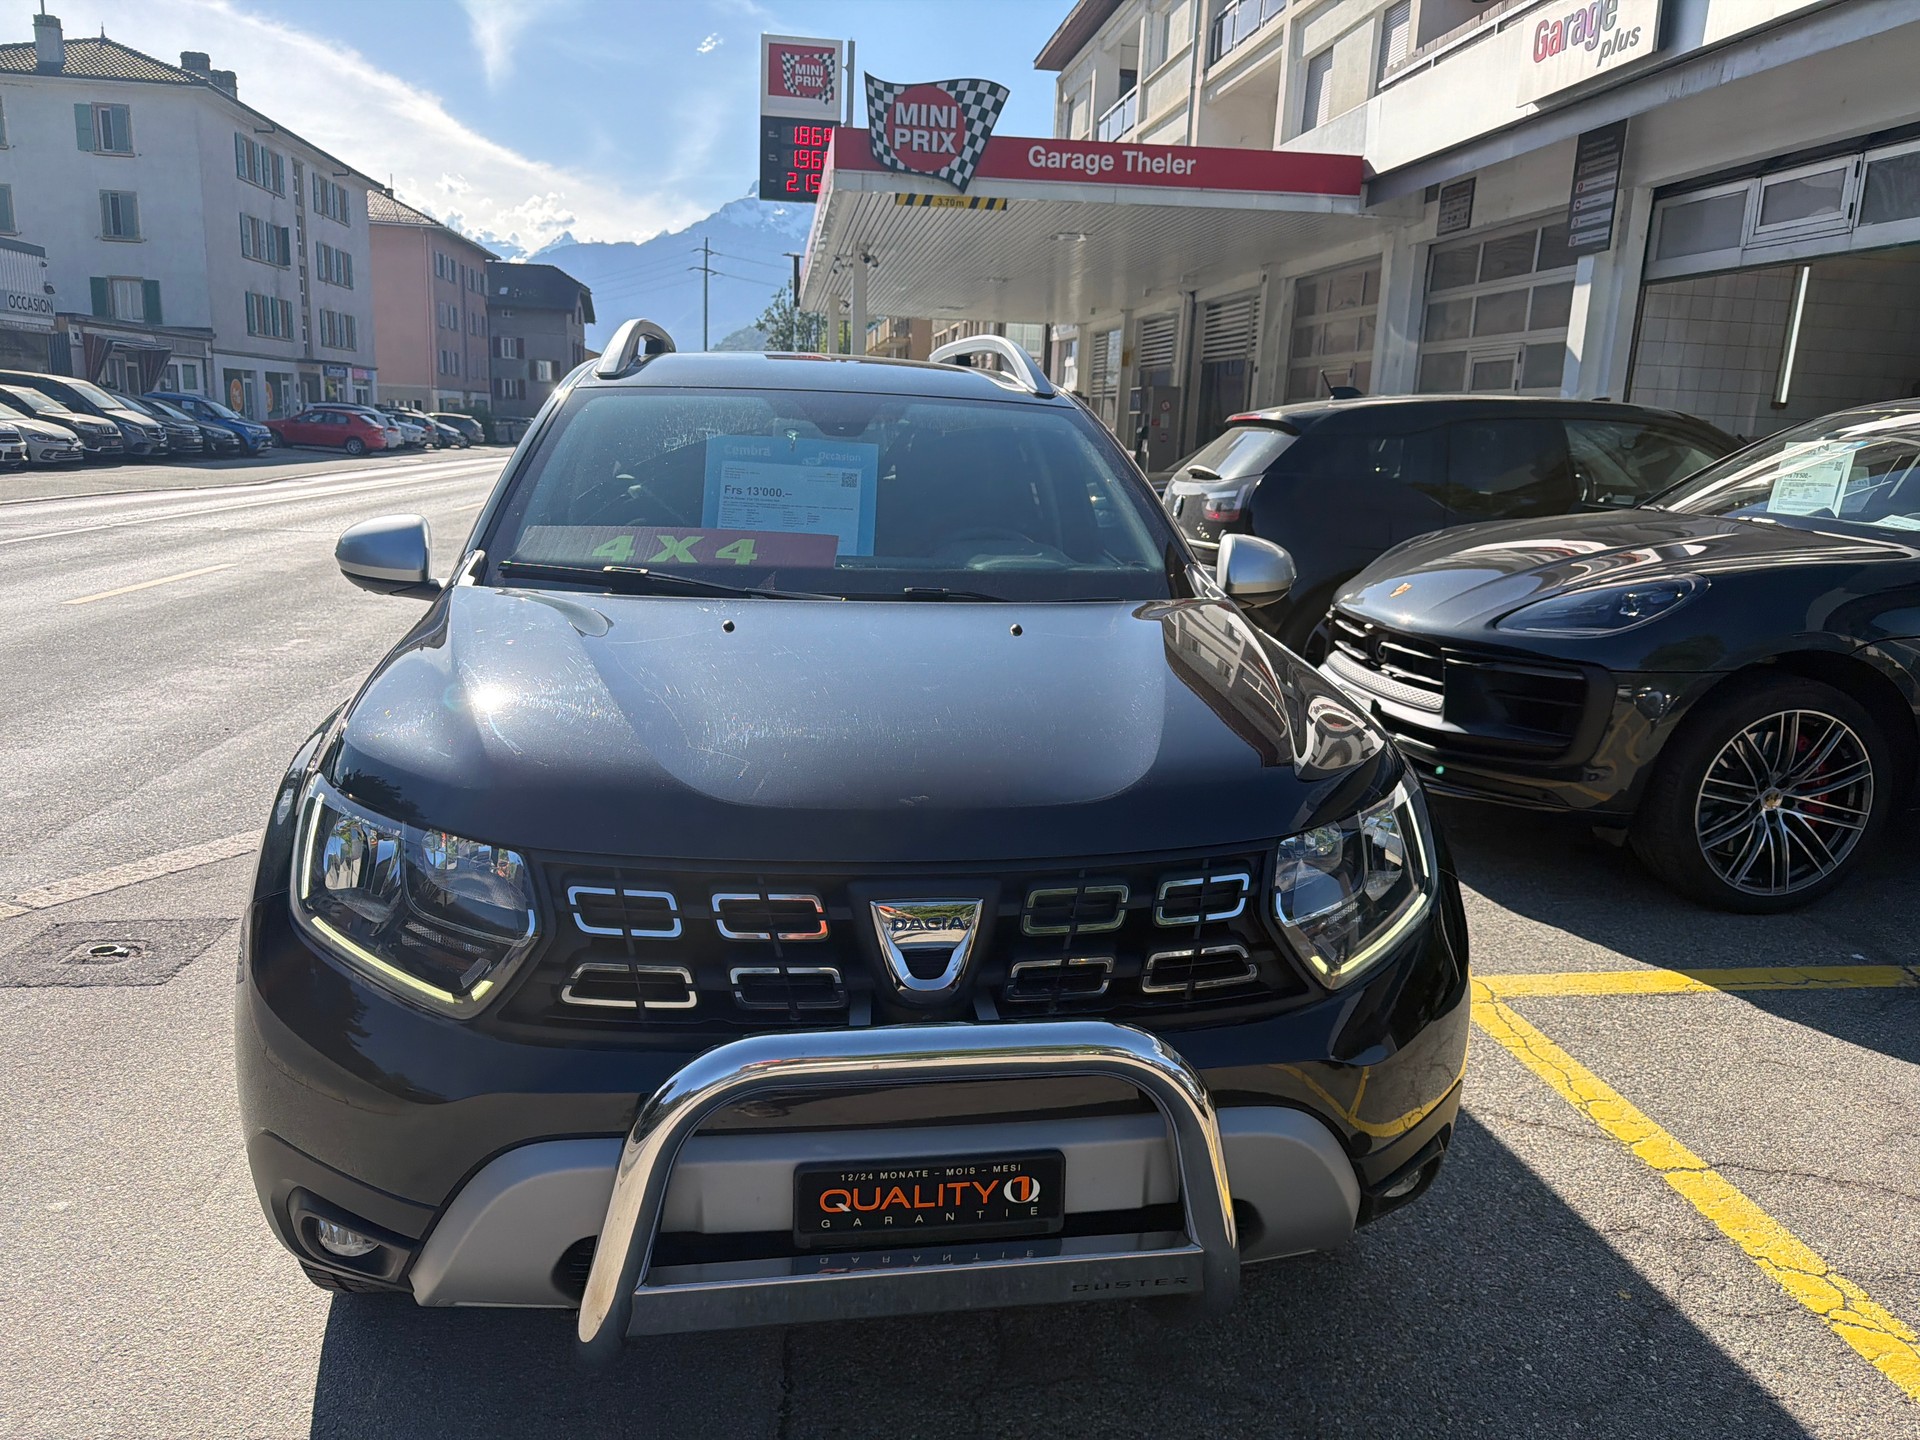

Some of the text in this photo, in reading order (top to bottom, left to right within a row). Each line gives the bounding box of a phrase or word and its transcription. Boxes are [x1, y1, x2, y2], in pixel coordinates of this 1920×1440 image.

[1533, 0, 1617, 63] Garage
[1596, 26, 1641, 67] plus
[795, 64, 823, 76] MINI
[794, 75, 823, 88] PRIX
[895, 102, 957, 128] MINI
[894, 129, 957, 153] PRIX
[1028, 145, 1196, 175] Garage Theler
[9, 294, 54, 314] OCCASION
[819, 452, 861, 462] Occasion
[724, 484, 743, 495] Frs
[891, 916, 964, 931] DACIA
[841, 1172, 873, 1181] 12/24
[880, 1170, 929, 1180] MONATE
[946, 1167, 976, 1176] MOIS
[993, 1164, 1021, 1174] MESI
[819, 1180, 999, 1213] QUALITY
[821, 1206, 1038, 1229] GARANTIE
[1072, 1276, 1189, 1292] DUSTER
